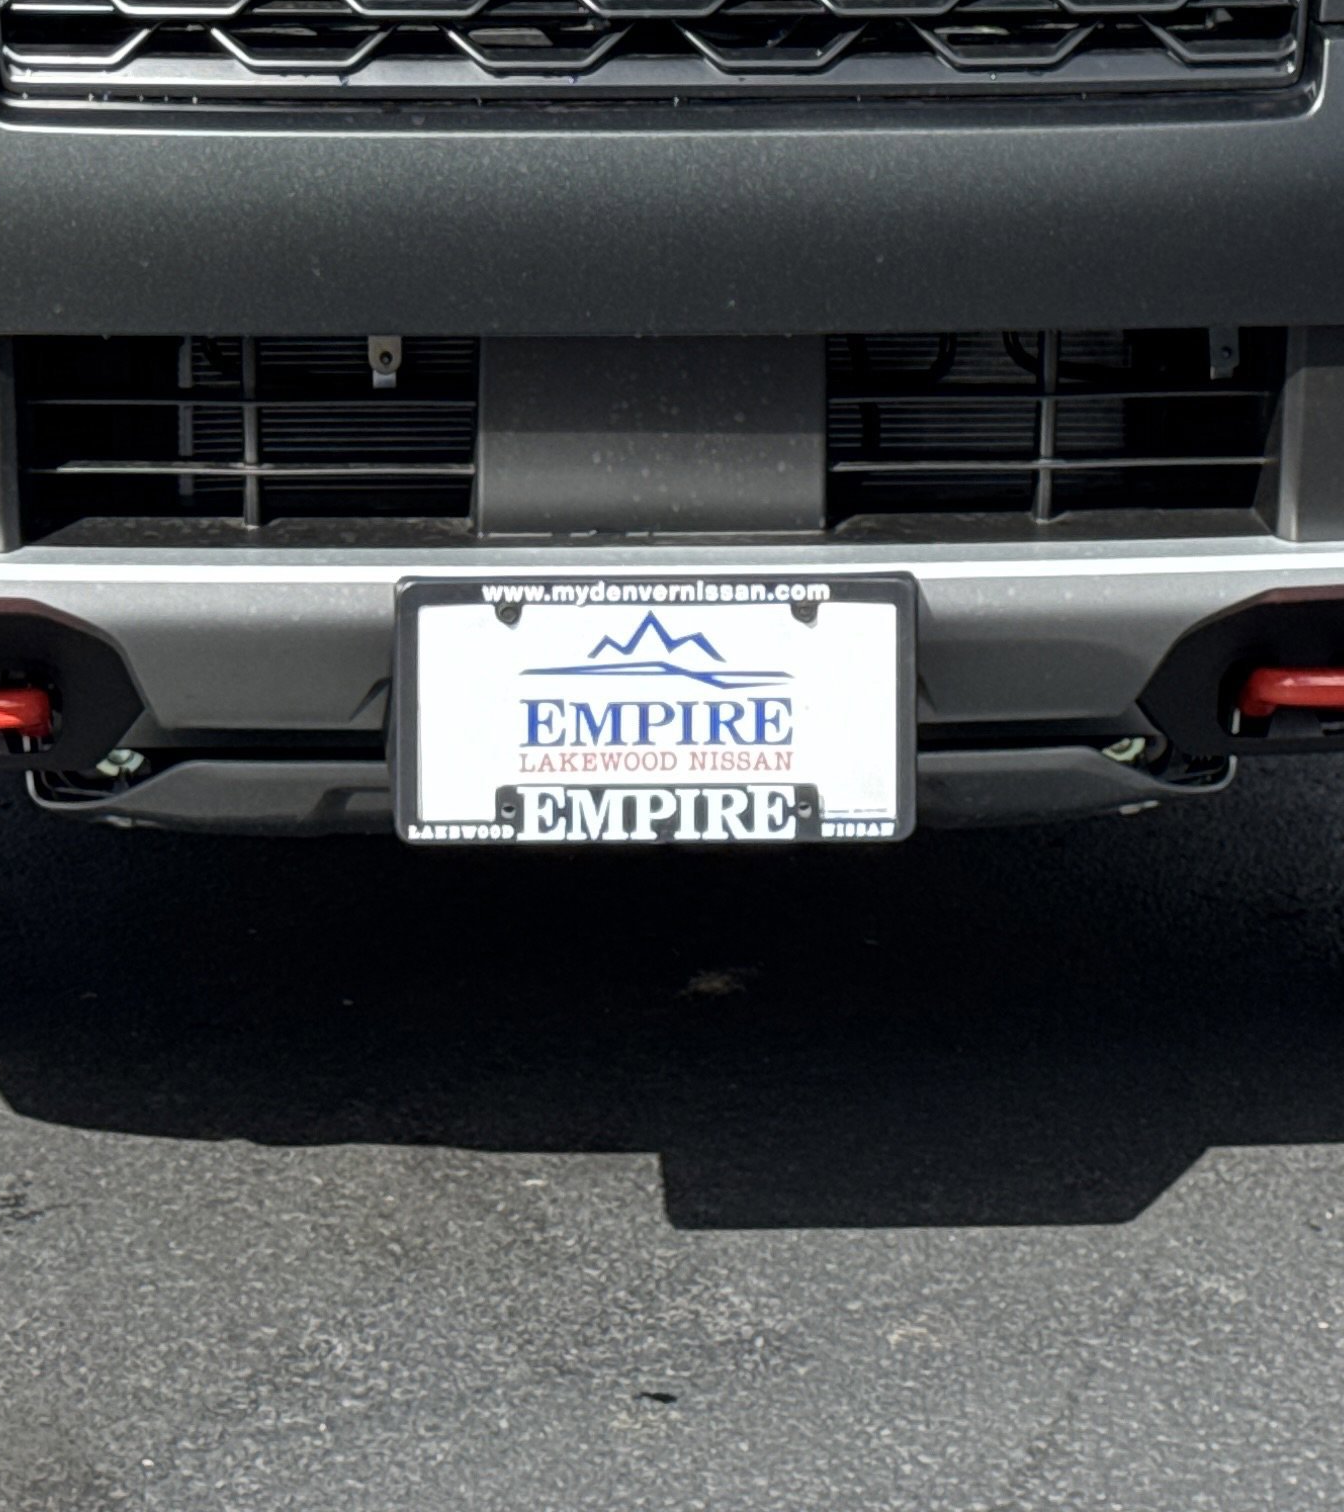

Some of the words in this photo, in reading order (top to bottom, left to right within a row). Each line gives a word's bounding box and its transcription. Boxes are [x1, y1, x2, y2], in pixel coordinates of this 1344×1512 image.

[482, 580, 831, 606] www.mydenvernissan.com
[518, 697, 794, 748] EMPIRE
[518, 751, 678, 773] LAKEWOOD
[689, 750, 794, 772] NISSAN
[516, 784, 796, 841] EMPIRE
